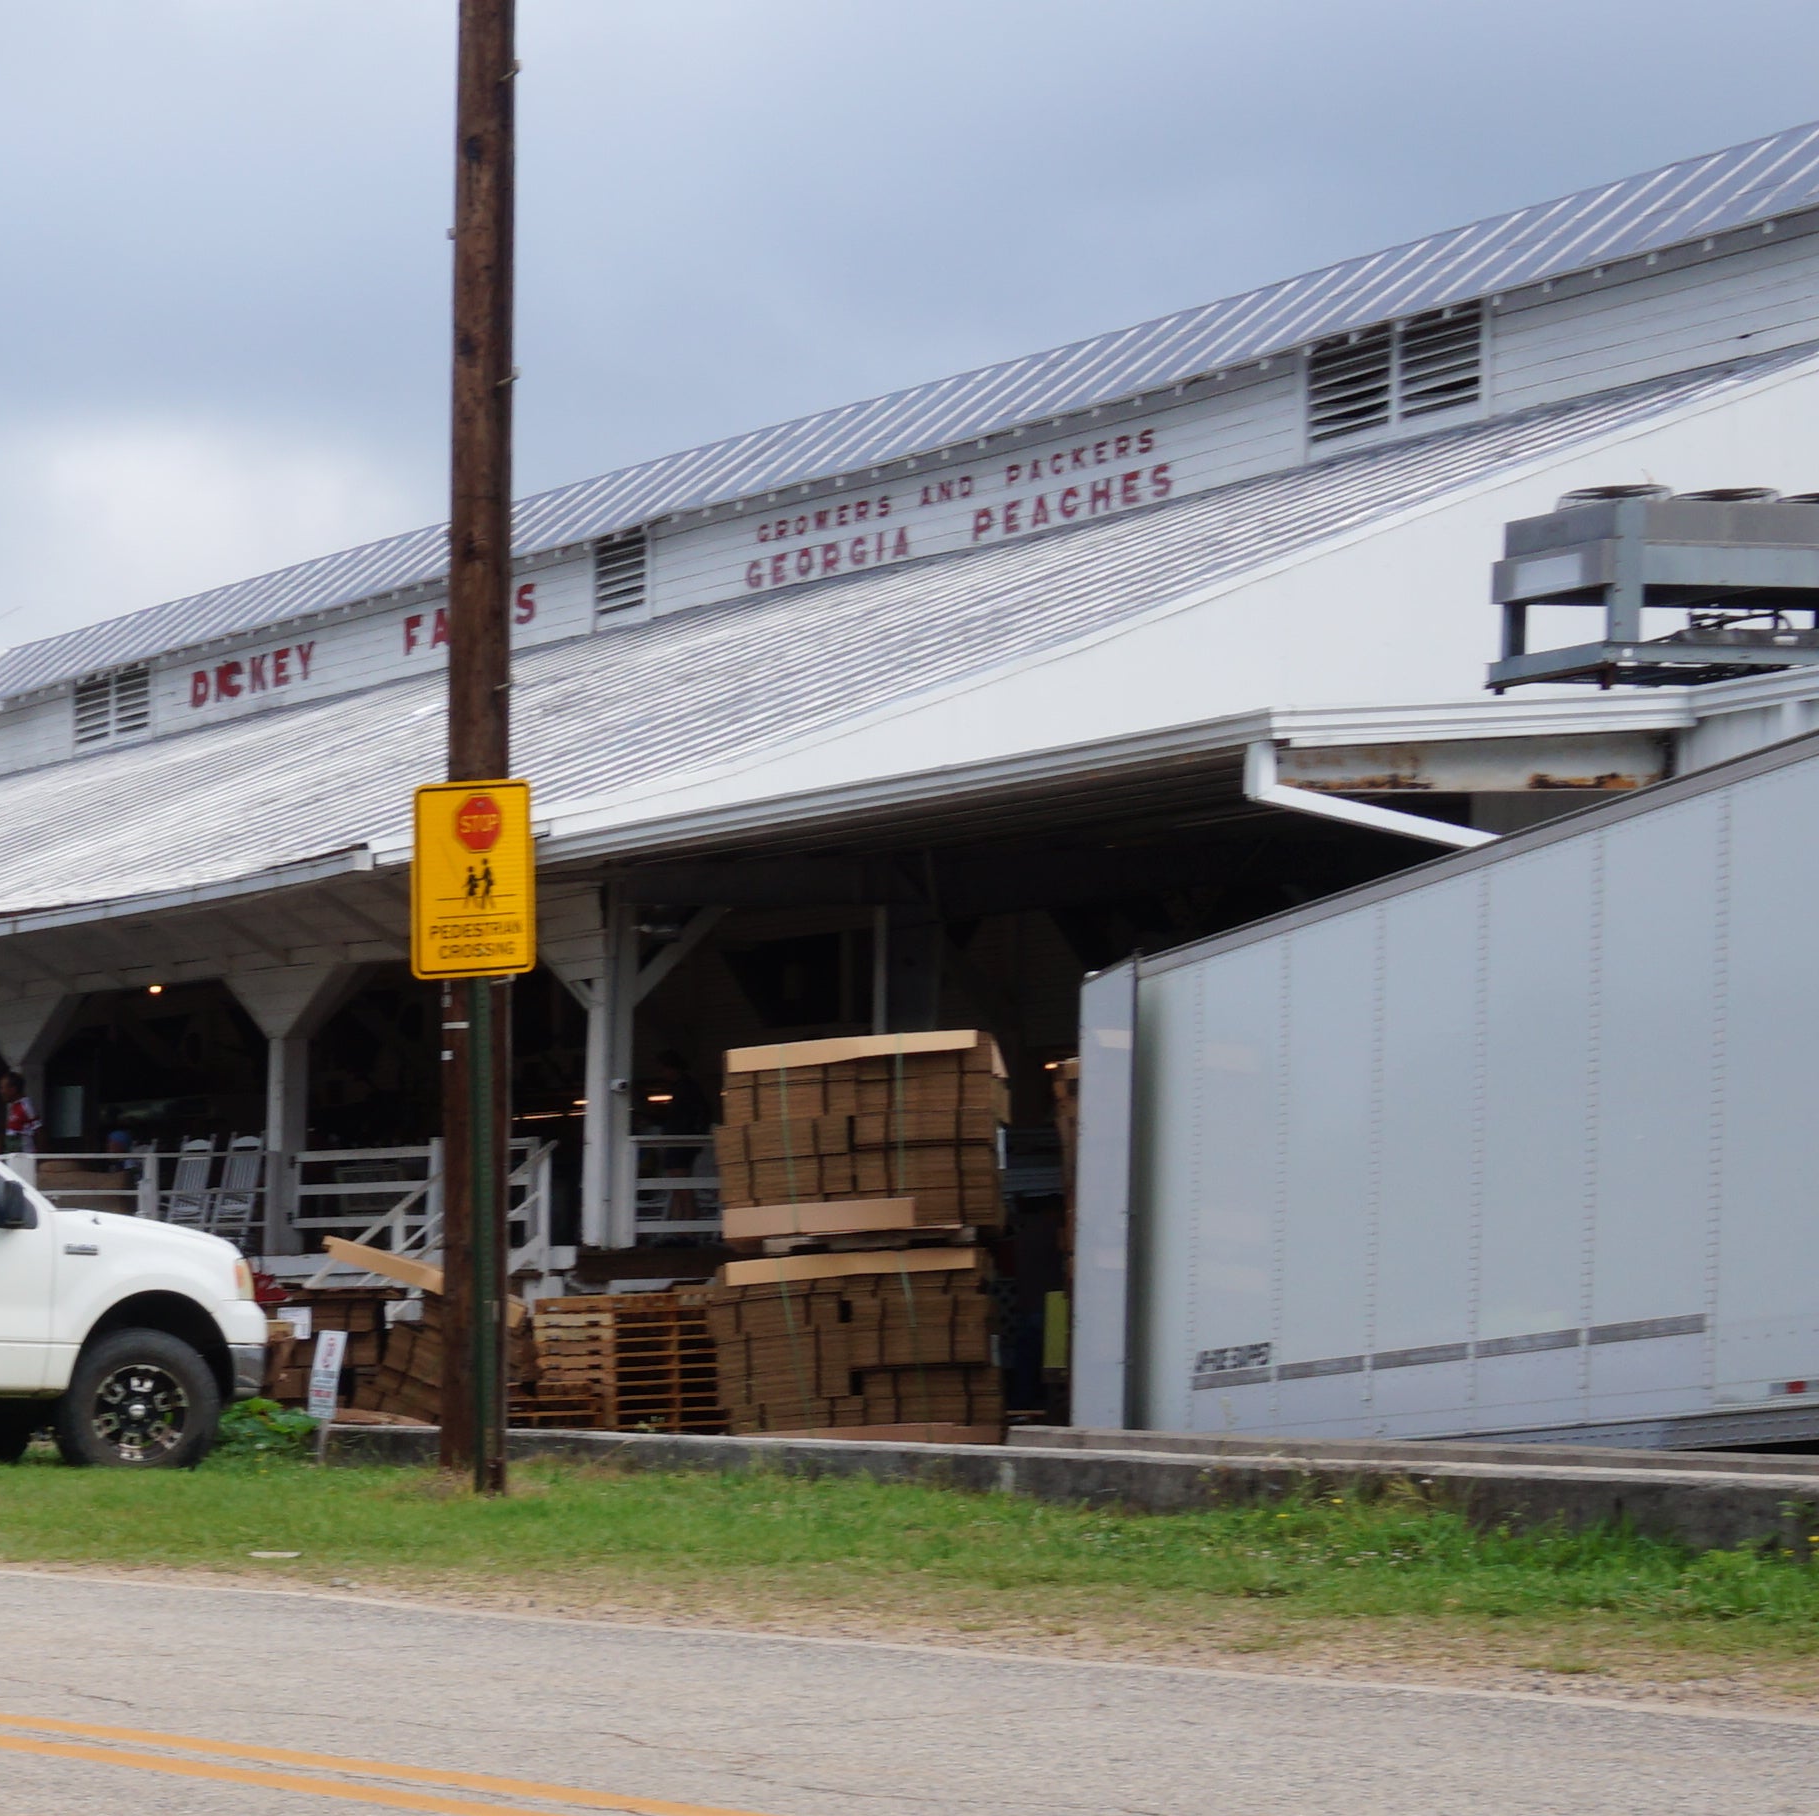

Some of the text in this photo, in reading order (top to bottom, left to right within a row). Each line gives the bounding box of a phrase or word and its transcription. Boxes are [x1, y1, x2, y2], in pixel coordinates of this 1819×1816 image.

[756, 428, 1157, 544] GROWERS AND PACKERS
[744, 463, 1174, 590] GEORGIA PEACHES
[189, 582, 537, 708] DICKEY FAS
[458, 813, 499, 834] STOP
[428, 920, 523, 940] PEDESTRIAN
[438, 940, 516, 960] CROSSING
